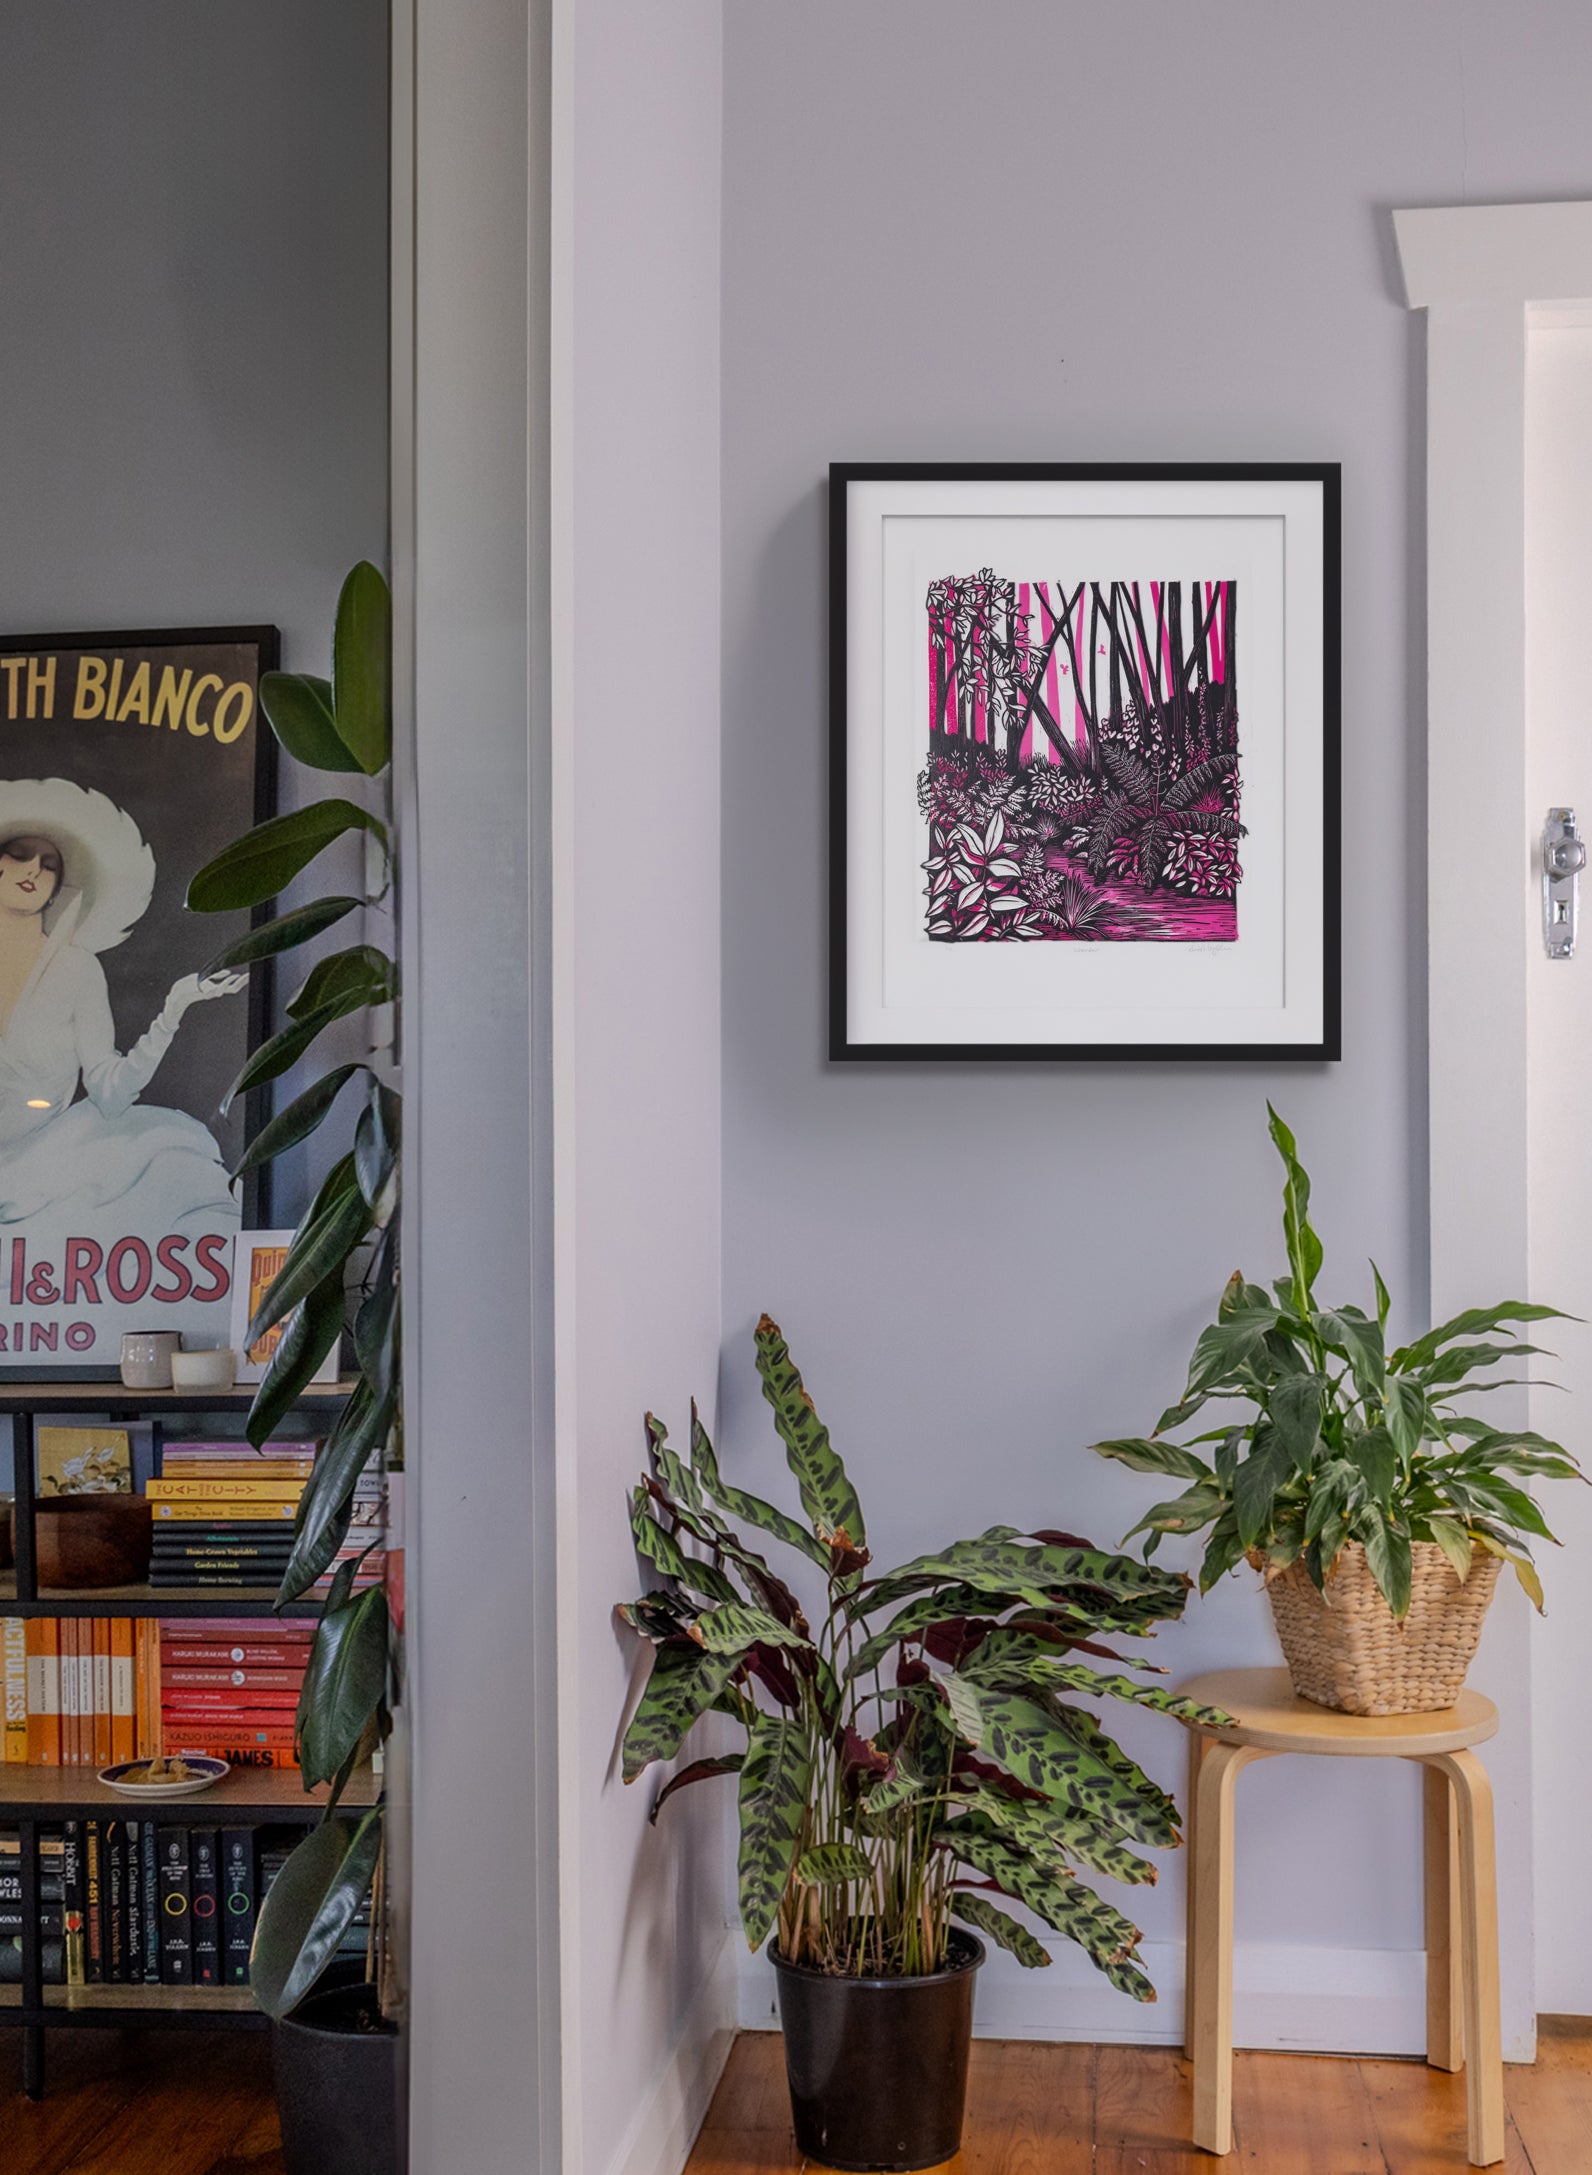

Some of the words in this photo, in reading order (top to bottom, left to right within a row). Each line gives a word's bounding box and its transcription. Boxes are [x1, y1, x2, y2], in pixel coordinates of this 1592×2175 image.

[73, 656, 253, 744] BIANCO
[0, 1234, 236, 1304] I&ROSS
[162, 1484, 197, 1495] CAT
[212, 1484, 257, 1496] CITY
[6, 1617, 25, 1721] ACTFULNESS
[170, 1732, 203, 1742] KAZUO
[203, 1733, 251, 1743] ISHIGURO
[224, 1750, 273, 1767] JAMES
[65, 1841, 76, 1886] HOBBIT
[88, 1880, 99, 1903] 451
